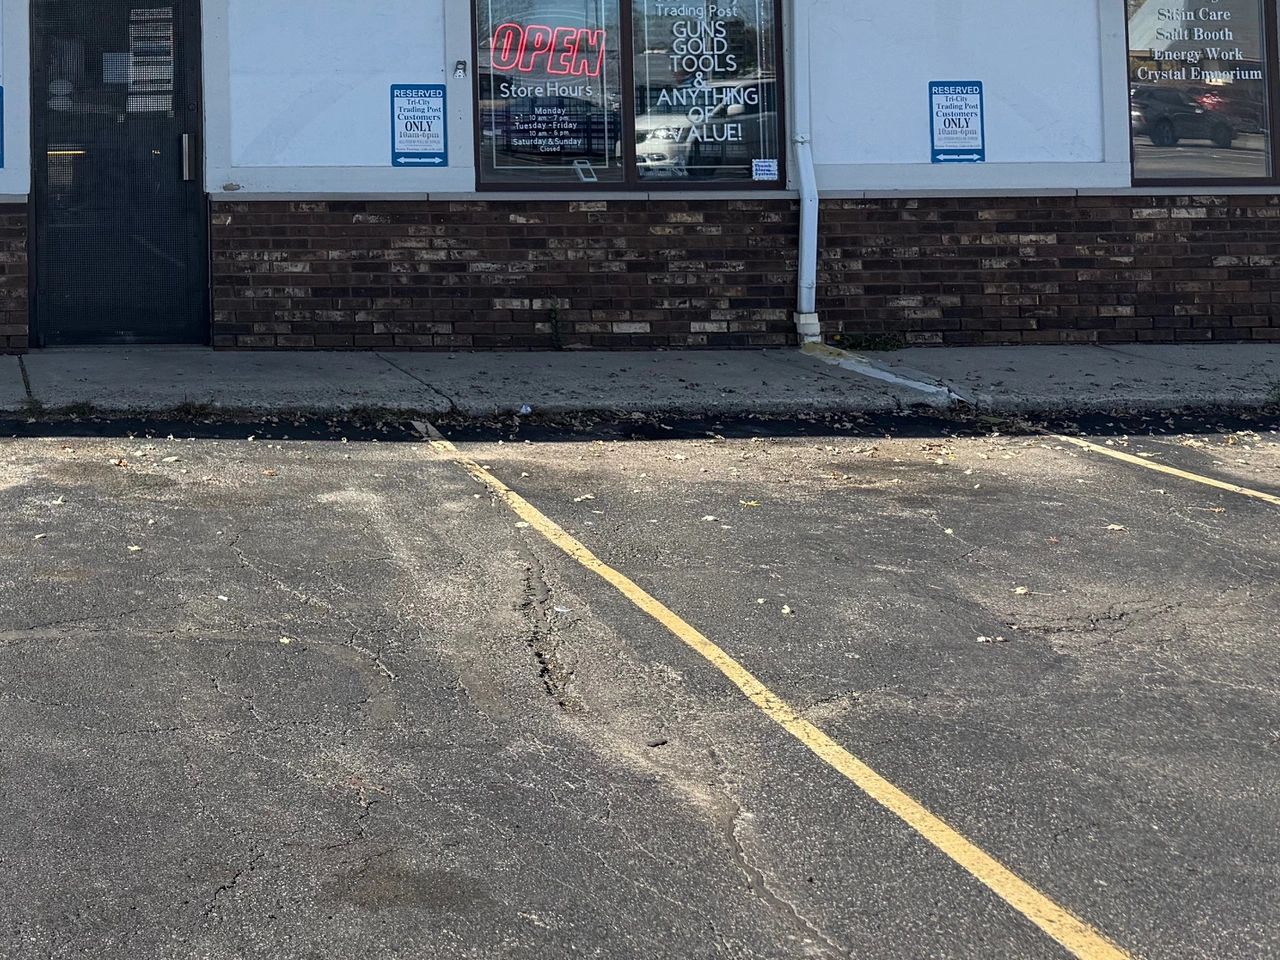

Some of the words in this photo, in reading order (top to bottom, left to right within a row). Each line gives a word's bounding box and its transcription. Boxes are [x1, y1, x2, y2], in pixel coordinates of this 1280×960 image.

[656, 4, 704, 18] Trading
[709, 4, 738, 17] Post
[1158, 8, 1195, 21] Skin
[1199, 8, 1231, 21] Care
[672, 21, 726, 38] GUNS
[1156, 28, 1188, 41] Salt
[1194, 28, 1233, 41] Booth
[489, 23, 607, 76] OPEN
[672, 38, 728, 55] GOLD
[1153, 48, 1201, 63] Energy
[1206, 48, 1244, 60] Work
[670, 55, 737, 72] TOOLS
[693, 72, 706, 88] &
[1137, 67, 1186, 81] Crystal
[1191, 67, 1263, 81] Emporium
[500, 83, 544, 97] Store
[546, 82, 593, 96] Hours
[657, 88, 758, 105] ANYTHING
[534, 107, 566, 115] Monday
[688, 106, 714, 123] OF
[405, 121, 433, 131] ONLY
[943, 118, 971, 128] ONLY
[555, 138, 581, 146] Sunday
